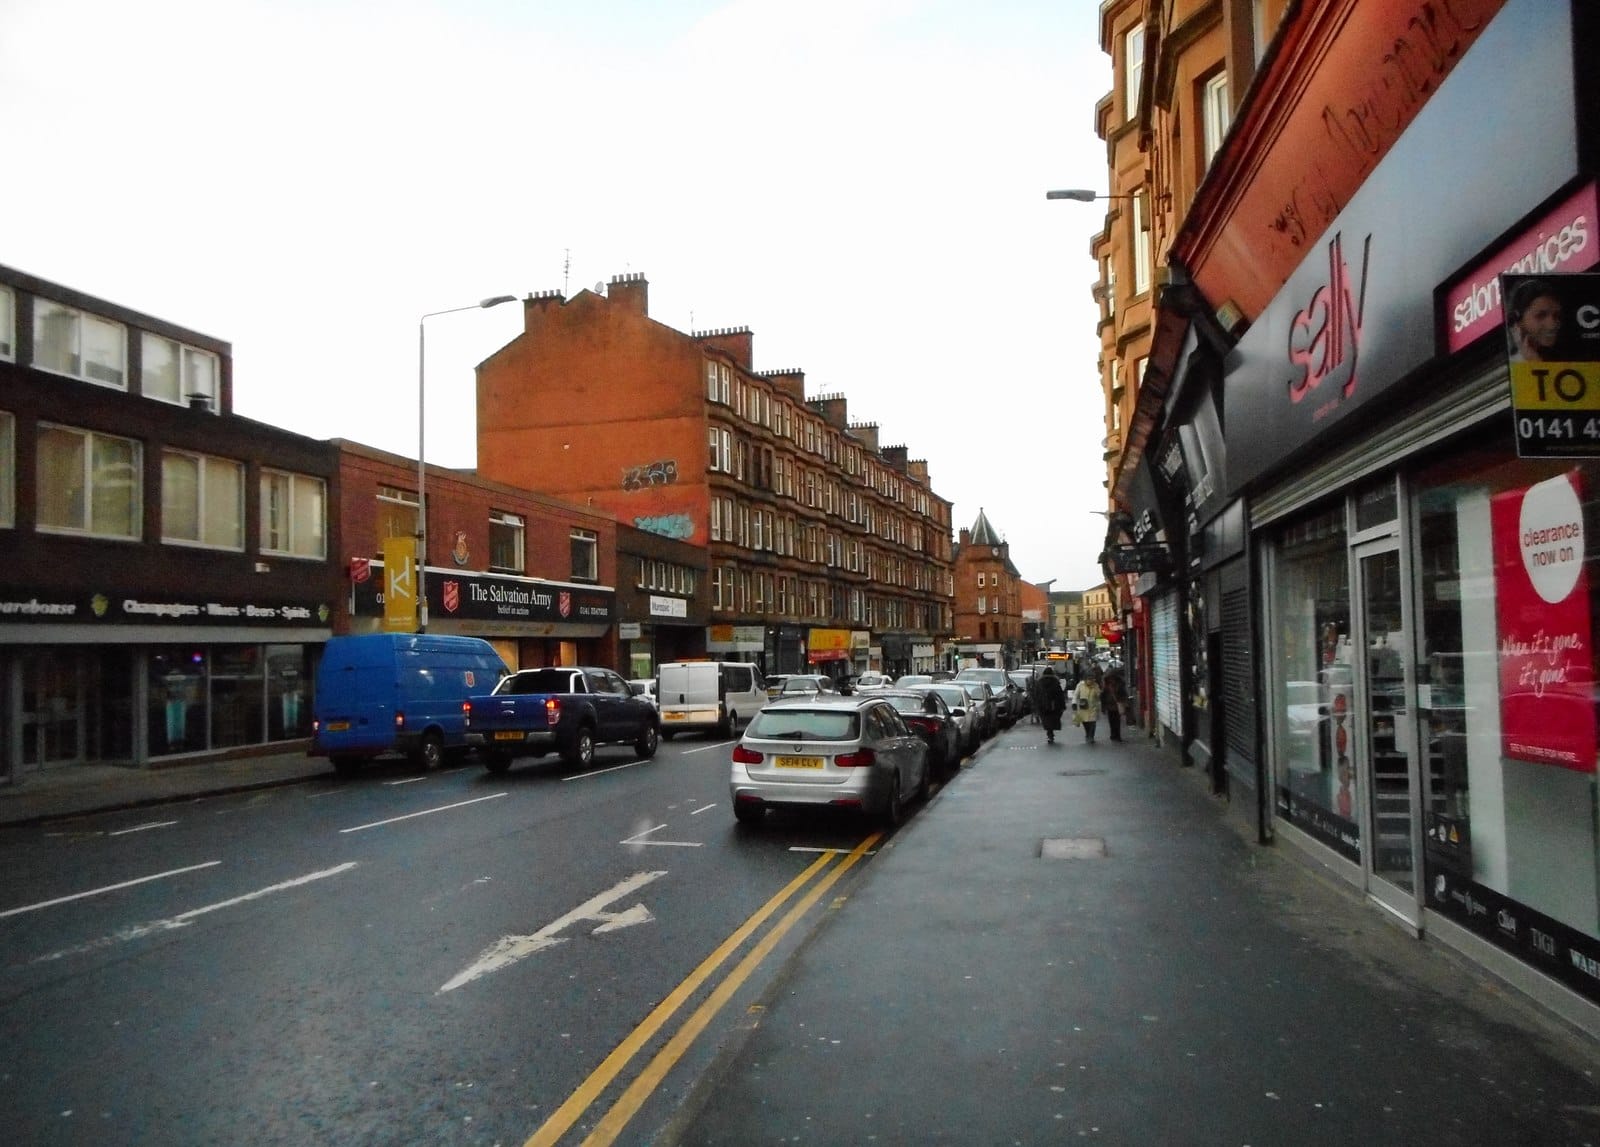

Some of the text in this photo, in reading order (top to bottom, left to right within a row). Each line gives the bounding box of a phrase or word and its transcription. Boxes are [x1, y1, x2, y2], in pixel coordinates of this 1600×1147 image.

[1287, 230, 1373, 404] sally
[1531, 368, 1586, 403] TO
[1519, 417, 1575, 439] 0141
[1524, 520, 1580, 549] clearance
[1532, 545, 1575, 567] now on
[123, 600, 200, 617] Champagnes
[470, 583, 553, 610] The Salvation Army
